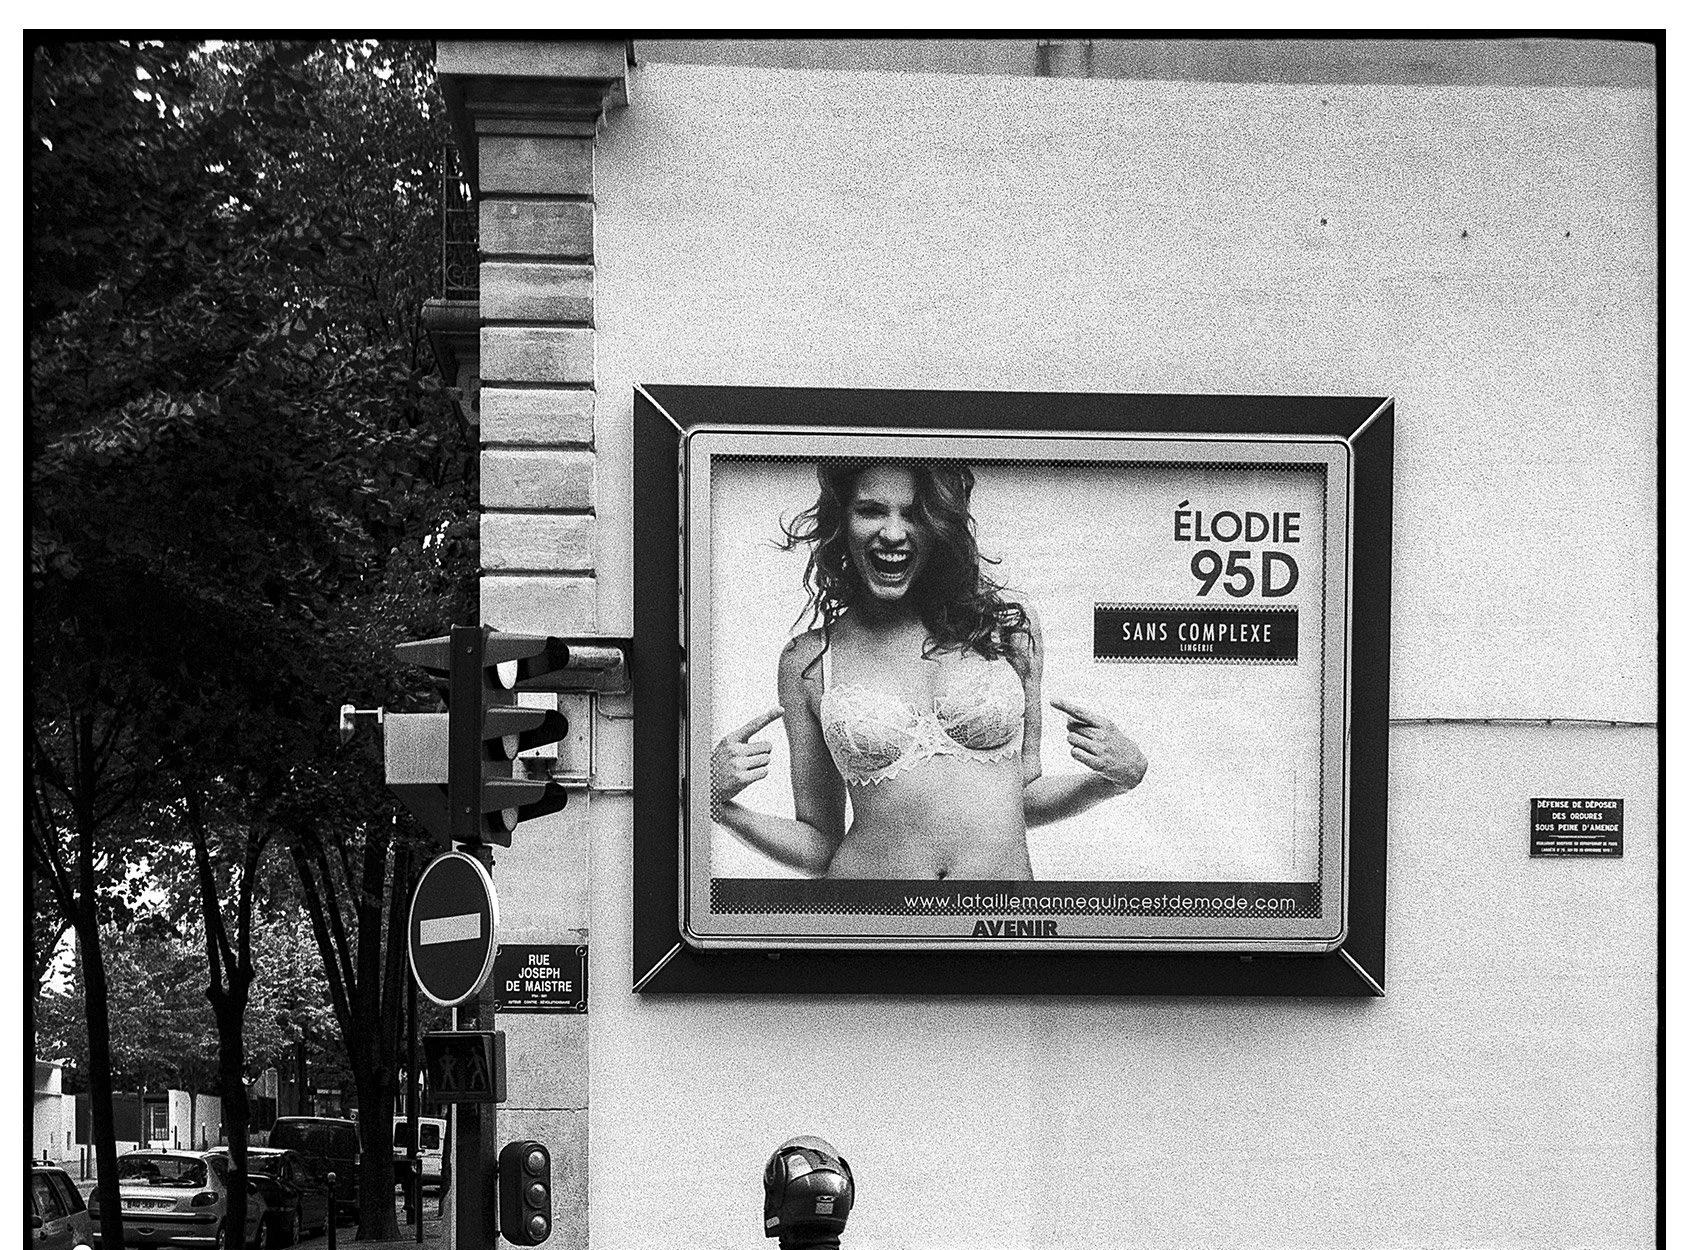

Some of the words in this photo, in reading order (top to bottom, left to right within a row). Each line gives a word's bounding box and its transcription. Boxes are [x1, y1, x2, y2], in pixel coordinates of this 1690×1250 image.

[1174, 499, 1300, 543] ÉLODIE
[1190, 549, 1299, 597] 95D
[1122, 622, 1168, 641] SANS
[1178, 623, 1271, 643] COMPLEXE
[1180, 644, 1213, 652] LINGERIE
[1537, 800, 1569, 808] DÉFENSE
[1585, 800, 1617, 808] DÉPOSER
[1552, 812, 1566, 820] DES
[1570, 812, 1603, 820] ORDURES
[1582, 824, 1619, 832] D'AMENDE
[904, 893, 1296, 913] www.lataillemannequincestdemode.com
[972, 920, 1058, 936] AVENIR
[528, 954, 550, 966] RUE
[518, 967, 560, 979] JOSEPH
[506, 981, 520, 992] DE
[525, 981, 572, 992] MAISTRE
